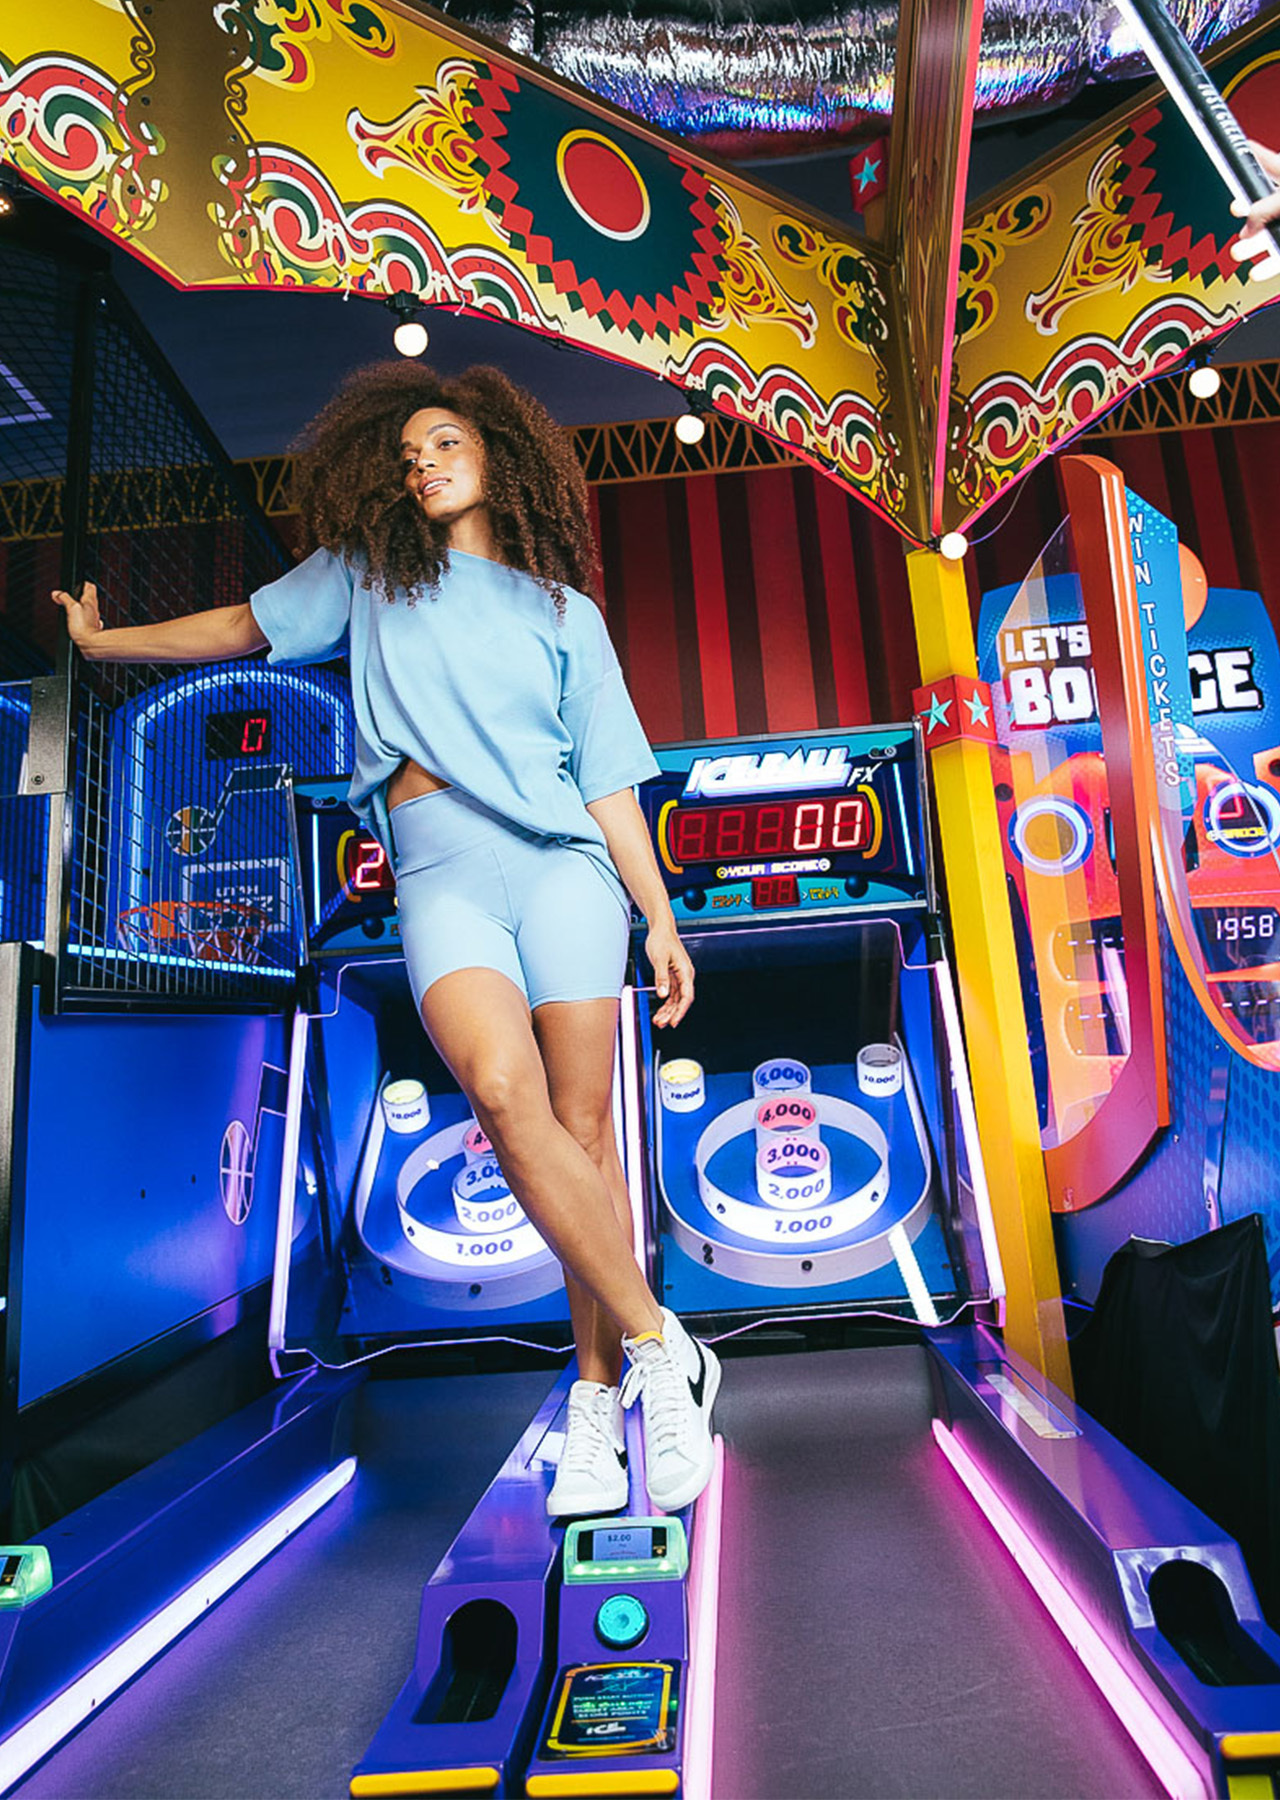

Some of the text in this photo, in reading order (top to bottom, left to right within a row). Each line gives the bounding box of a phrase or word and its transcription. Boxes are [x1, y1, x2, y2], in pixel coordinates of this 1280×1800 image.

[1004, 624, 1091, 663] LET'S
[1141, 603, 1180, 786] TICKETS
[847, 762, 883, 787] FX
[727, 860, 820, 877] YOUR SCORE
[1216, 915, 1275, 941] 1958
[762, 1104, 812, 1123] 4,000
[767, 1144, 820, 1164] 3,000
[607, 1534, 632, 1542] $2.00
